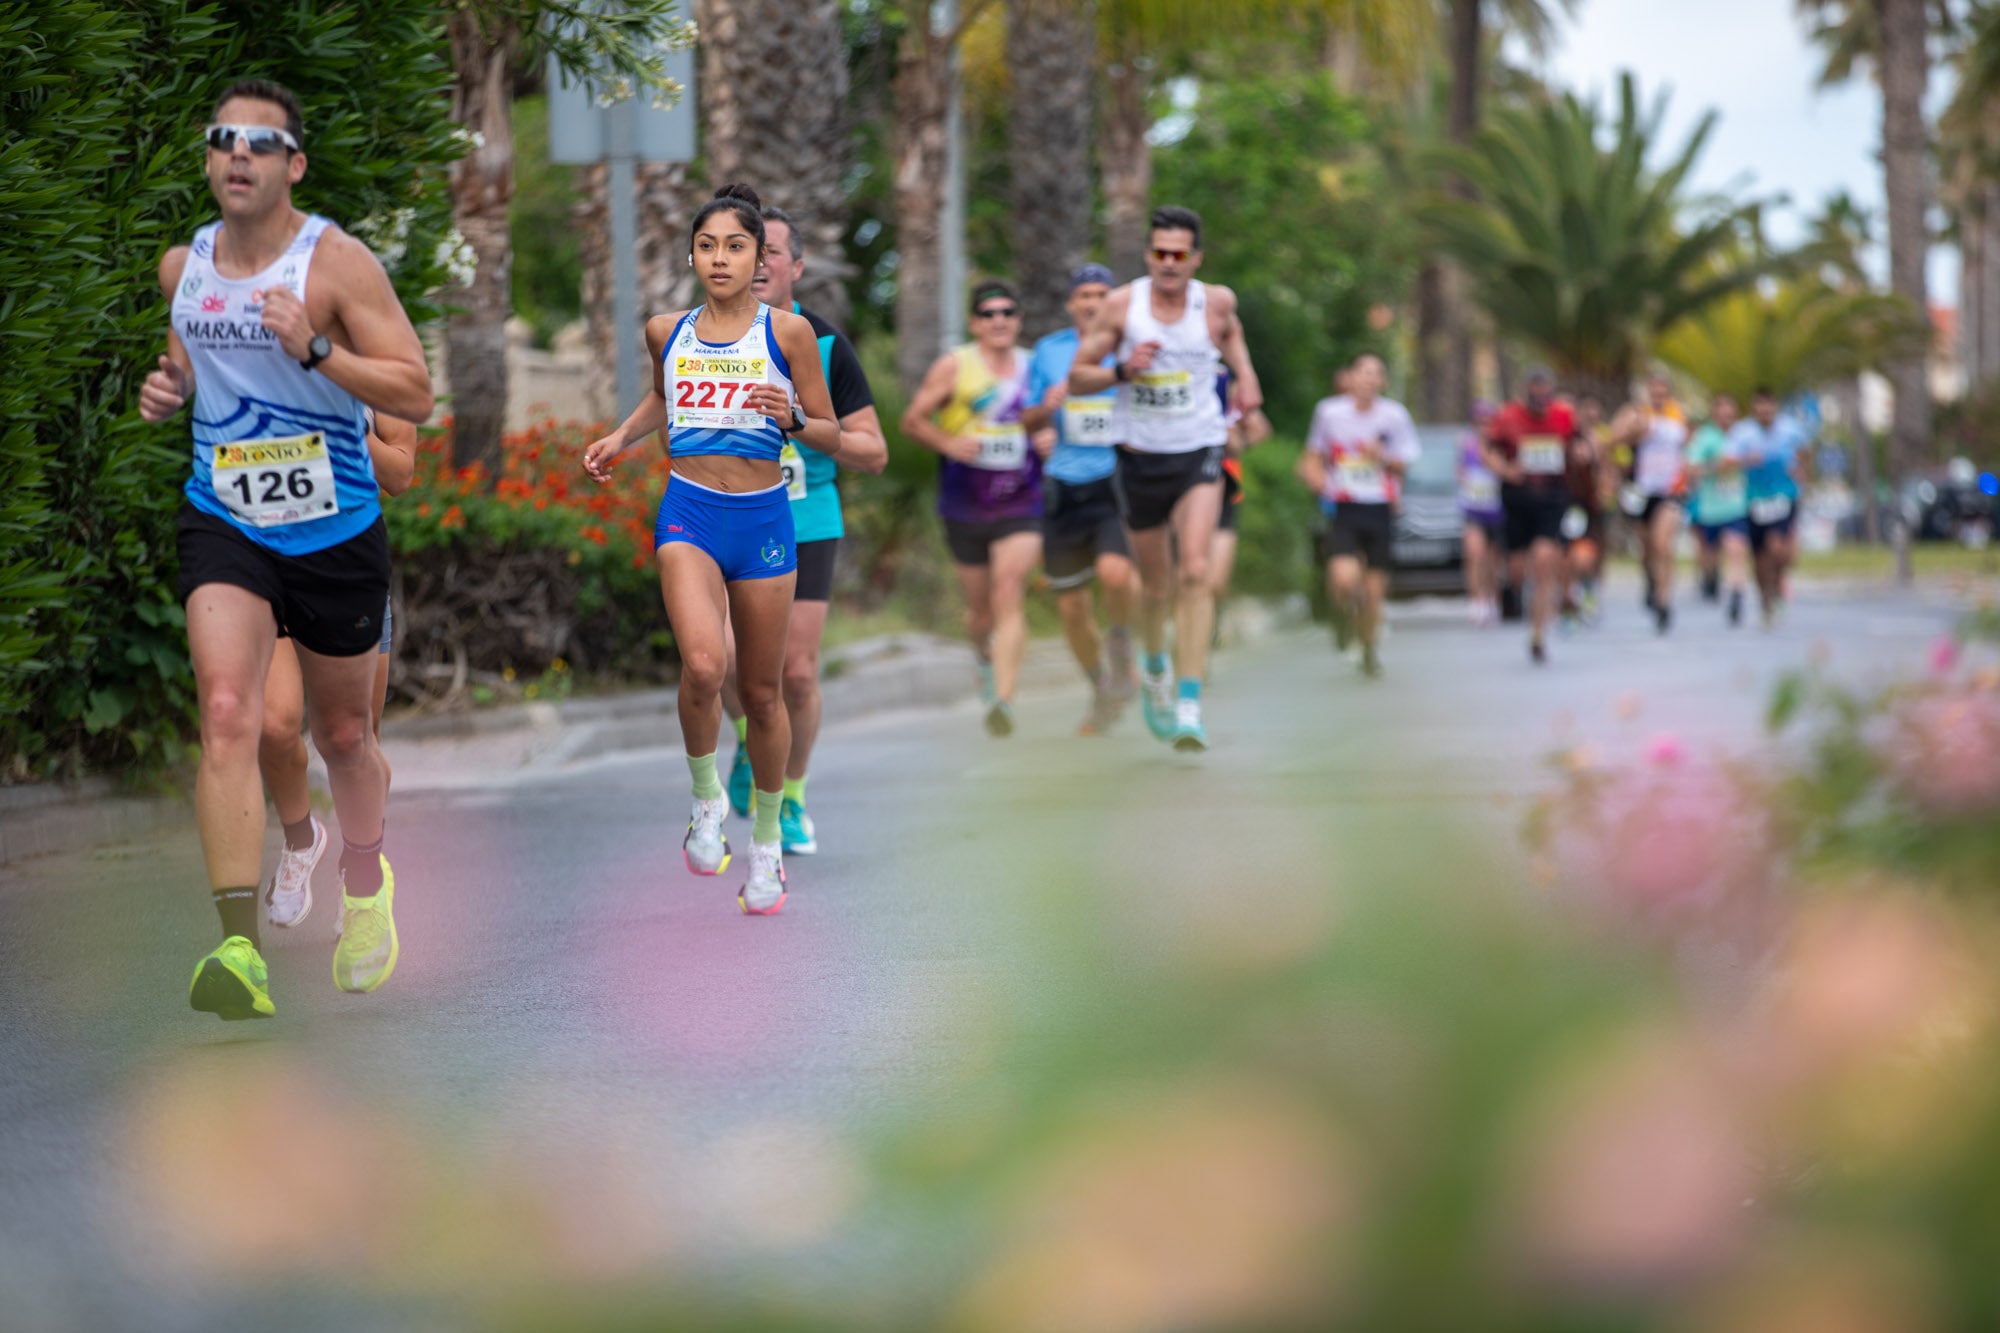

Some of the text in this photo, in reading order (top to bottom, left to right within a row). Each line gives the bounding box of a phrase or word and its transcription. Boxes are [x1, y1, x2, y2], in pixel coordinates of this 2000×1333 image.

[186, 321, 277, 340] MARACEN
[686, 360, 747, 374] 38 FONDO
[232, 468, 314, 505] 126
